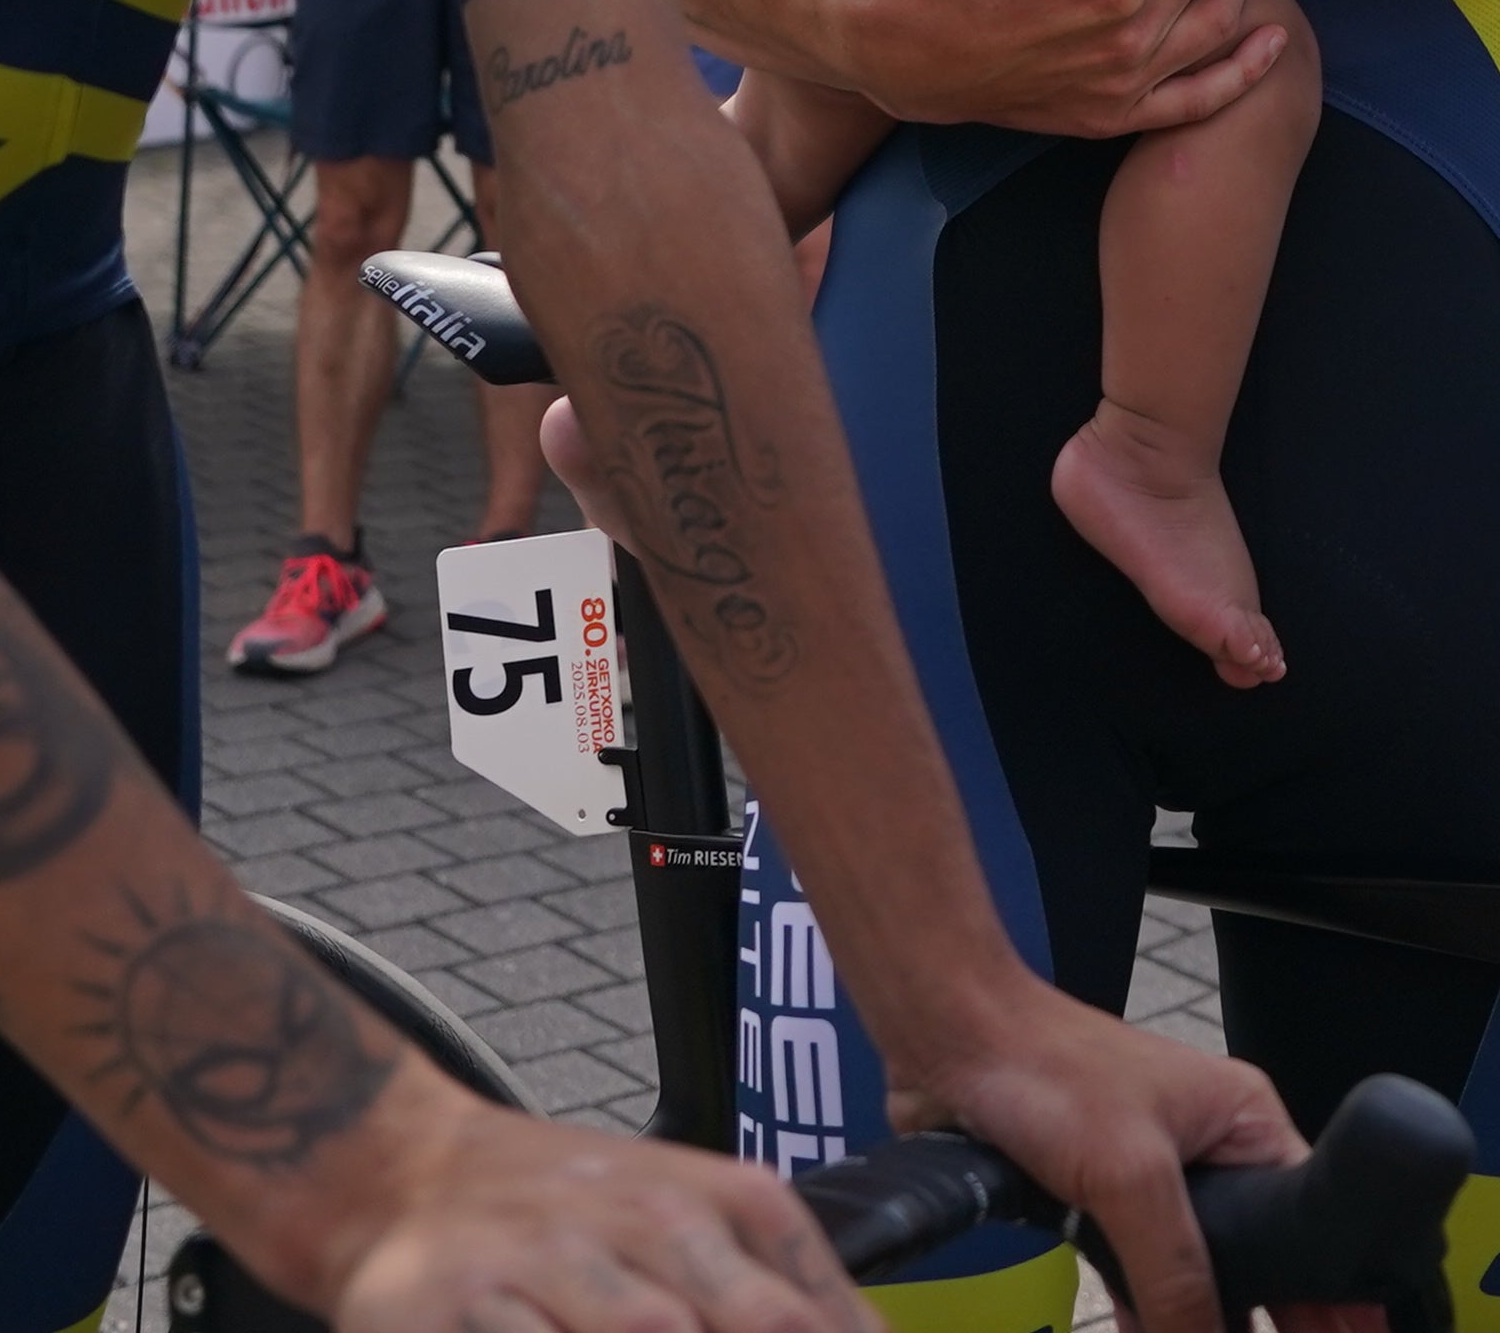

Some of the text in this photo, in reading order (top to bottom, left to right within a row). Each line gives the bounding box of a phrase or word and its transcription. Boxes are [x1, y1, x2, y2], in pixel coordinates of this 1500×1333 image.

[364, 265, 400, 296] selle
[447, 588, 563, 717] 75
[580, 597, 616, 744] 80. GETXOKO
[571, 662, 590, 755] 2025.08.03
[585, 659, 604, 755] ZIRKUITUA
[666, 847, 692, 865] Tim
